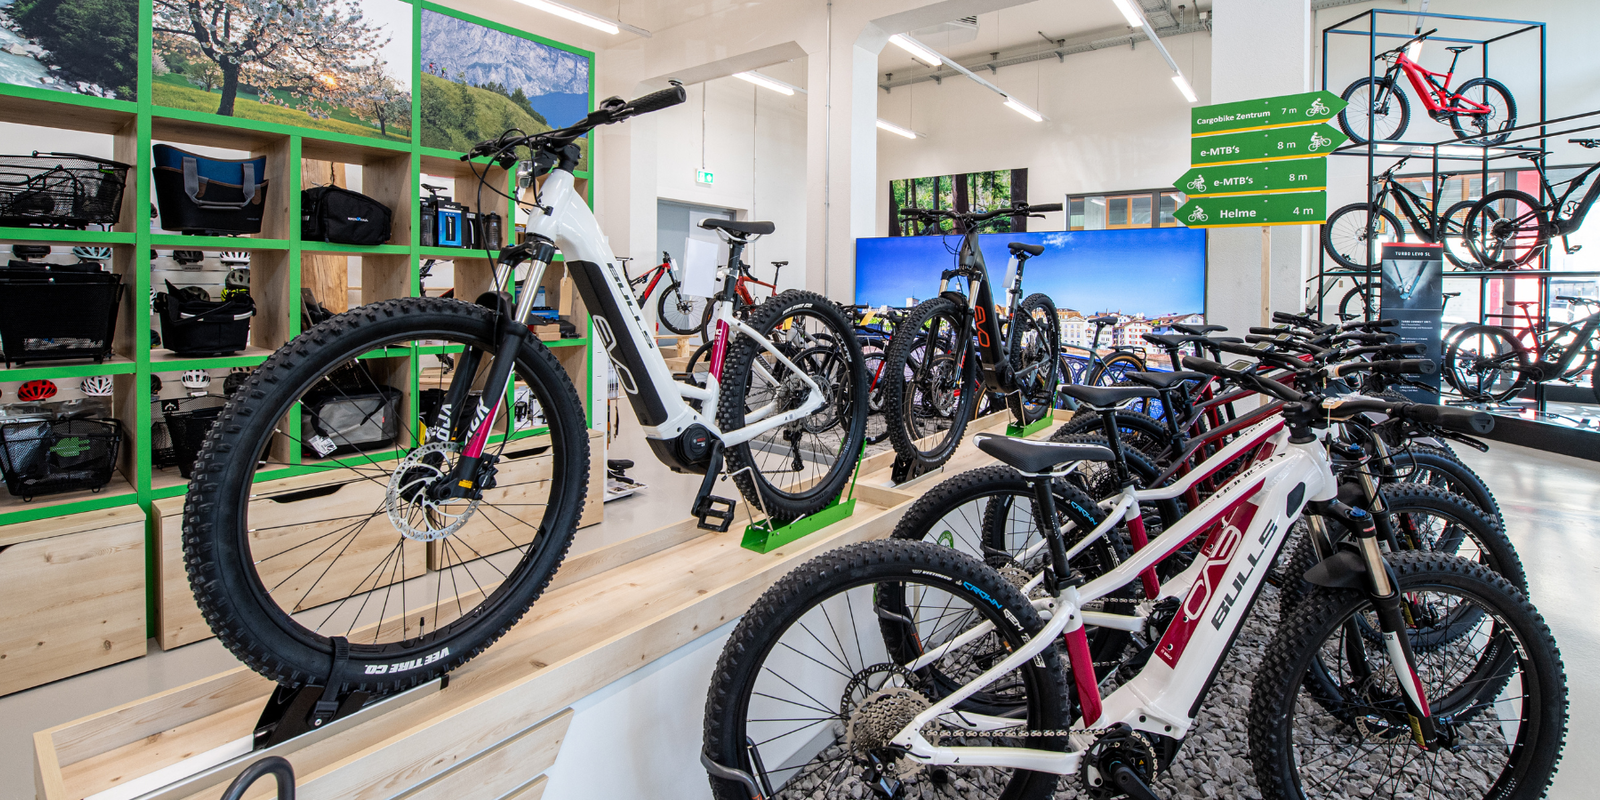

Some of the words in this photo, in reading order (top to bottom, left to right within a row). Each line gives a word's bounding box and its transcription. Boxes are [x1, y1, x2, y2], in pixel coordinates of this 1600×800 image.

[1197, 115, 1234, 125] Cargobike
[1236, 110, 1270, 120] Zentrum
[1277, 141, 1284, 149] 8
[1220, 209, 1256, 219] Helme
[1293, 207, 1299, 215] 4
[606, 262, 655, 349] BULLS
[974, 305, 990, 348] EVO
[592, 314, 639, 395] EVO
[1070, 500, 1098, 526] CROWN
[1210, 518, 1278, 631] BULLS
[963, 581, 1003, 610] CROWN
[1003, 608, 1024, 631] GEM
[388, 657, 423, 674] TIRE
[424, 646, 450, 666] VEE
[364, 664, 389, 674] CO.
